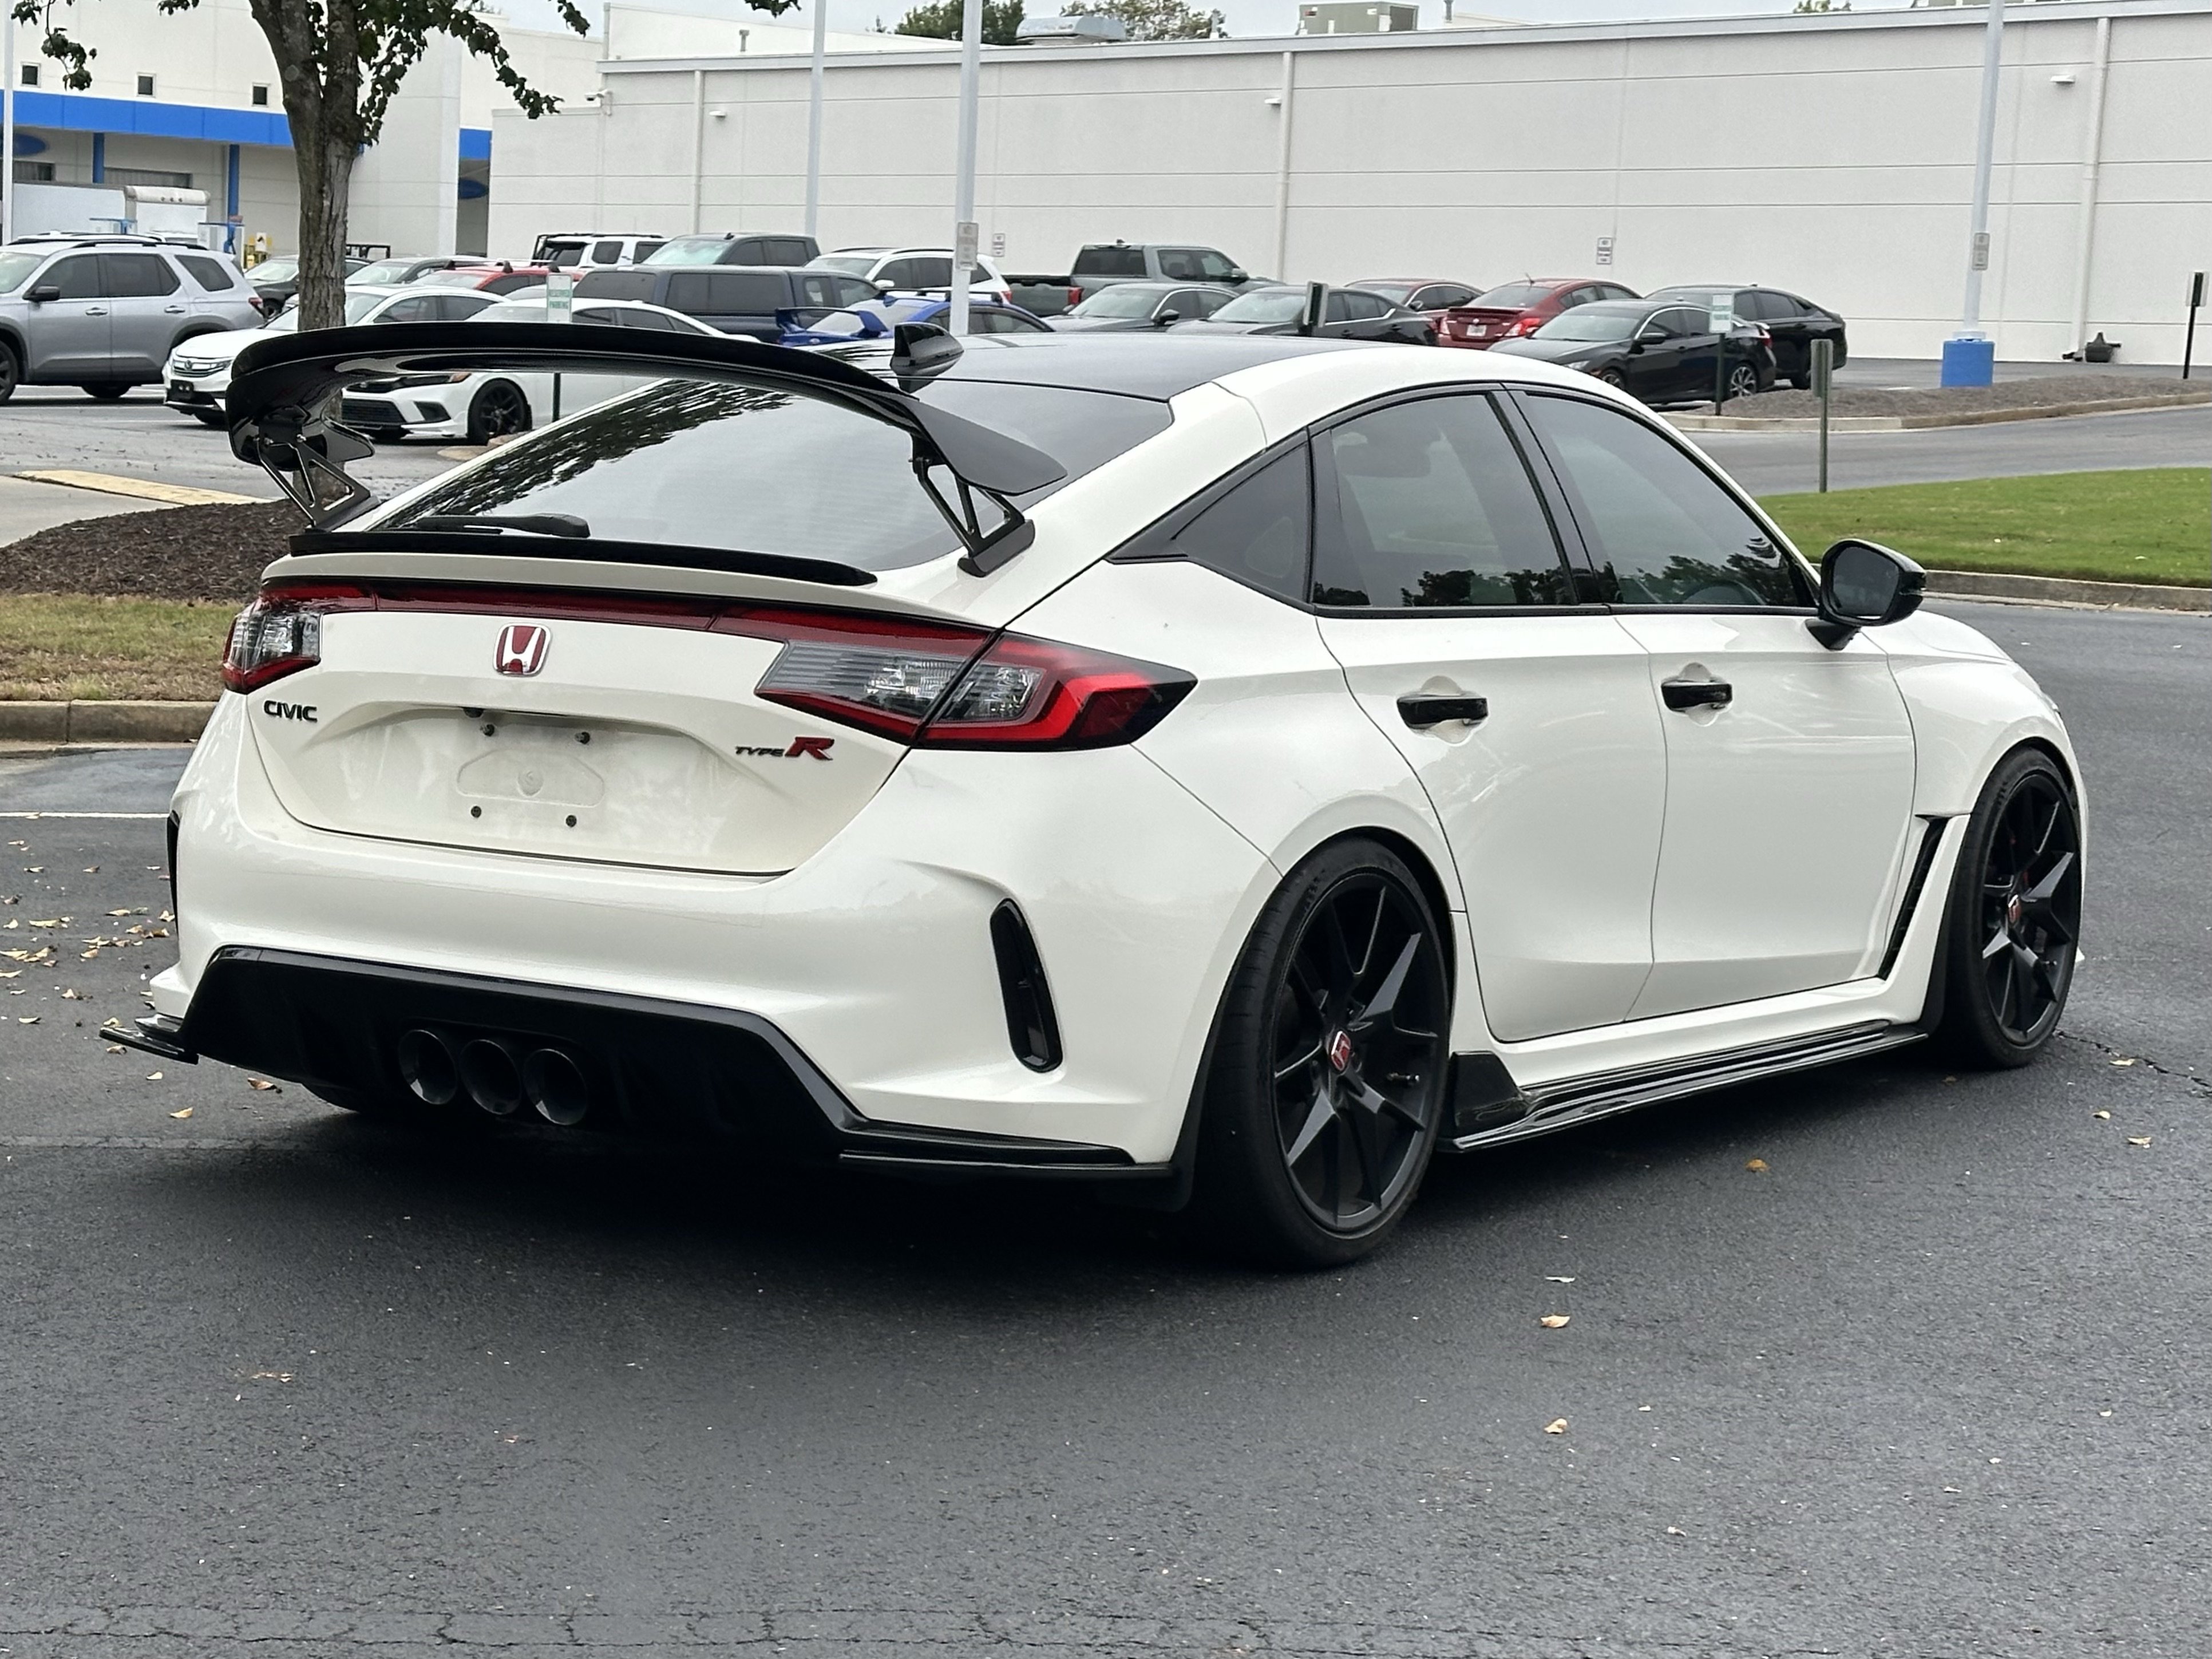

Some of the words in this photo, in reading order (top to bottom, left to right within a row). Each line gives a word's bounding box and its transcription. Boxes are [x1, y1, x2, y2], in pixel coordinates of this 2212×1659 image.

[263, 700, 318, 724] CIVIC
[735, 745, 785, 757] TYPE
[784, 736, 835, 761] R
